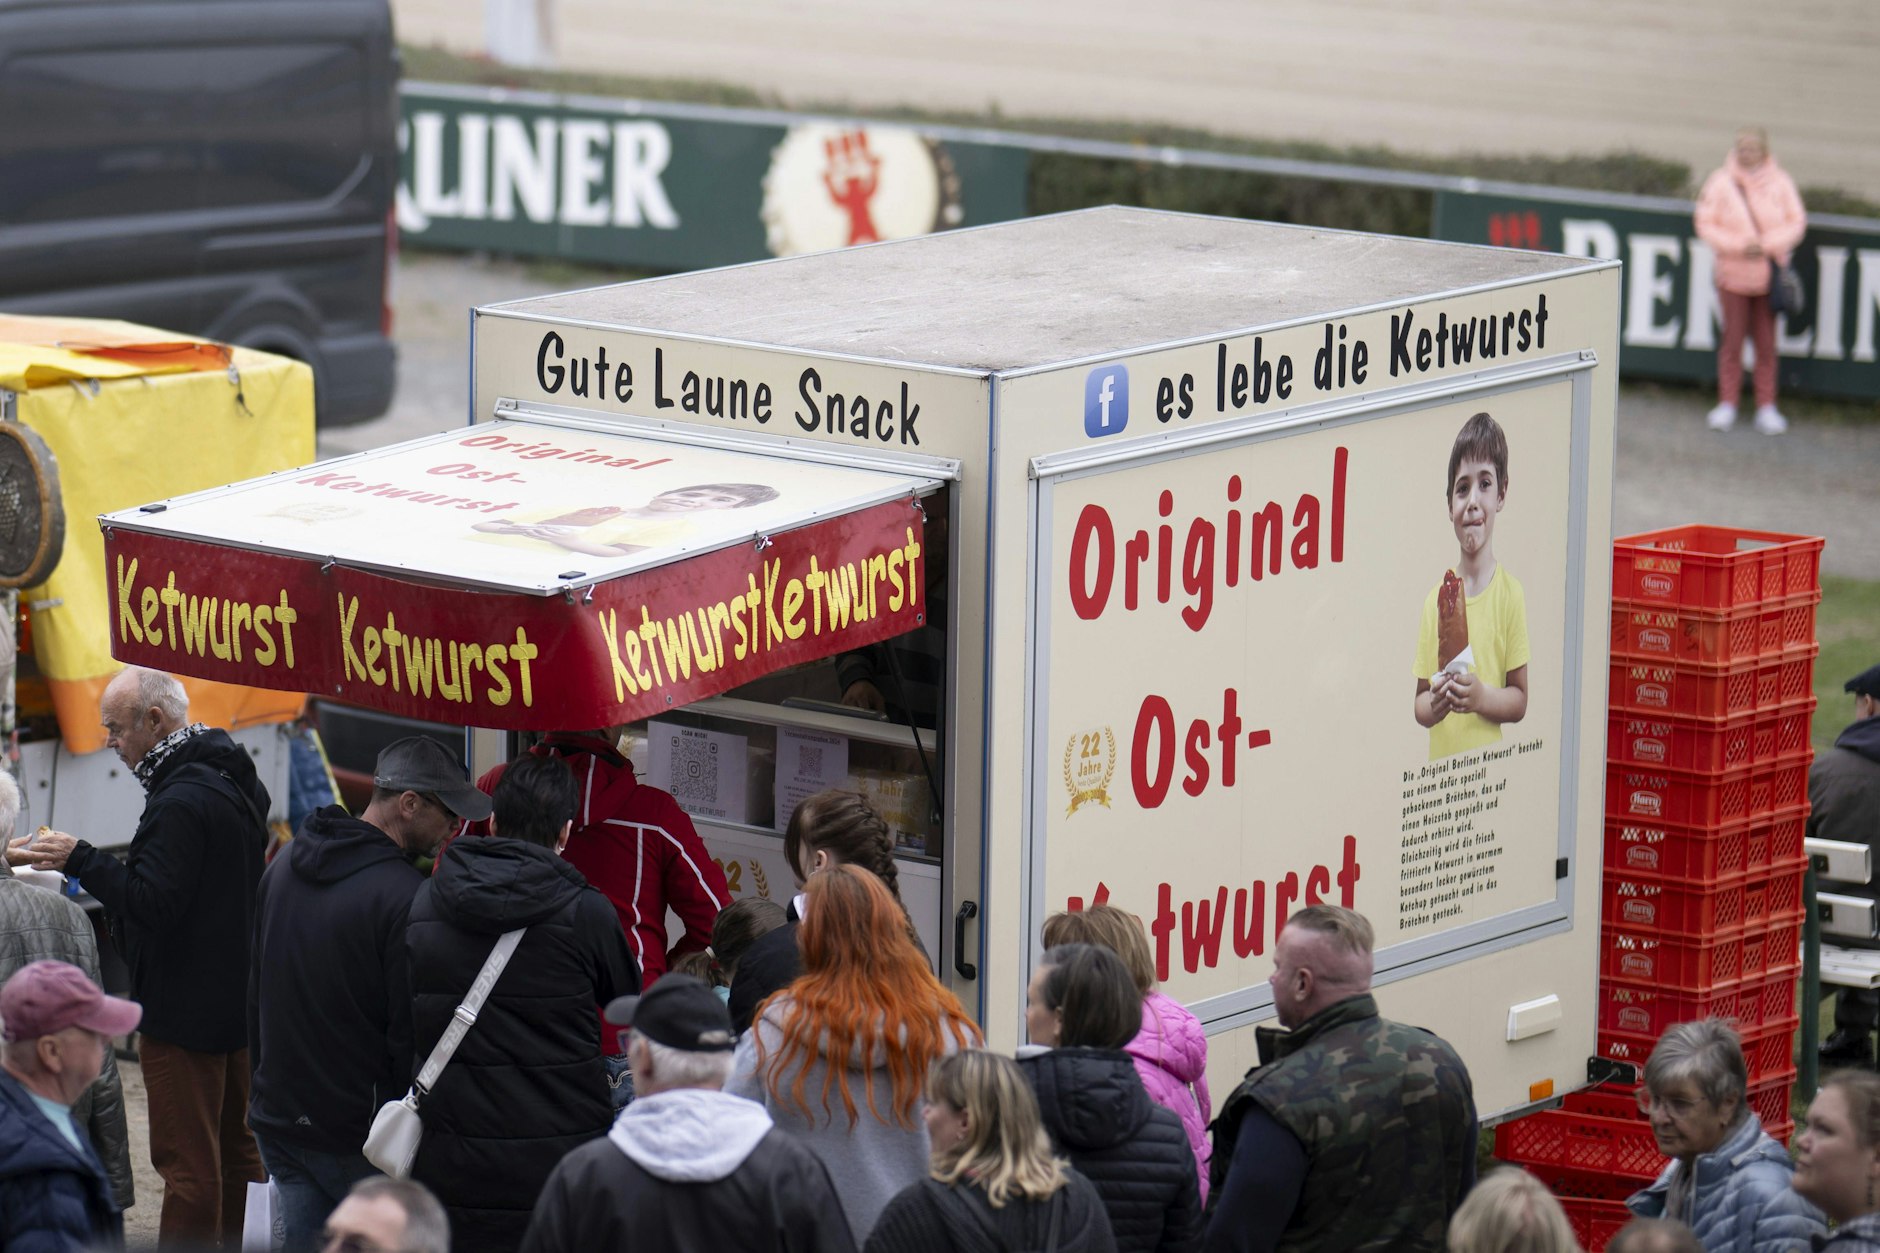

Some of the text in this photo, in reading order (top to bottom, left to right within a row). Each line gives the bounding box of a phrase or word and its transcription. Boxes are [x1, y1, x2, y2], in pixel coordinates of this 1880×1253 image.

[1156, 294, 1548, 423] es lebe die Ketwurst
[537, 331, 920, 446] Gute Laune Snack
[459, 435, 673, 470] Original
[426, 463, 527, 483] Ost-
[296, 472, 520, 514] Ketwurst
[1069, 446, 1348, 632] Original
[1644, 576, 1671, 591] Harry
[116, 554, 538, 707] Ketwurst Ketwurst
[1641, 631, 1668, 645] Harry
[1639, 685, 1666, 700] Harry
[1081, 731, 1101, 759] 22
[1131, 688, 1271, 808] Ost-
[1404, 771, 1414, 782] Die
[1417, 761, 1448, 780] „Original
[1453, 756, 1480, 770] Berliner
[1519, 739, 1542, 754] besteht
[1636, 740, 1664, 754] Harry
[1078, 760, 1102, 777] Jahre
[1403, 768, 1486, 799] aus einem dafür speziell
[1402, 779, 1507, 818] gebackenem Brötchen, das auf
[1402, 797, 1498, 831] einen Heizstab gespießt und
[1633, 792, 1659, 808] Harry
[1401, 830, 1495, 864] Gleichzeitig wird die frisch
[1402, 821, 1474, 847] dadurch erhitzt wird.
[1401, 847, 1503, 881] frittierte Ketwurst in warmem
[1629, 848, 1656, 864] Harry
[1400, 880, 1497, 913] Ketchup getaucht und in das
[1401, 864, 1494, 897] besonders lecker gewürztem
[1067, 835, 1360, 982] twurst
[1400, 904, 1463, 929] Brötchen gesteckt.
[1626, 902, 1653, 918] Harry
[1623, 956, 1650, 971] Harry
[1621, 1010, 1648, 1025] Harry
